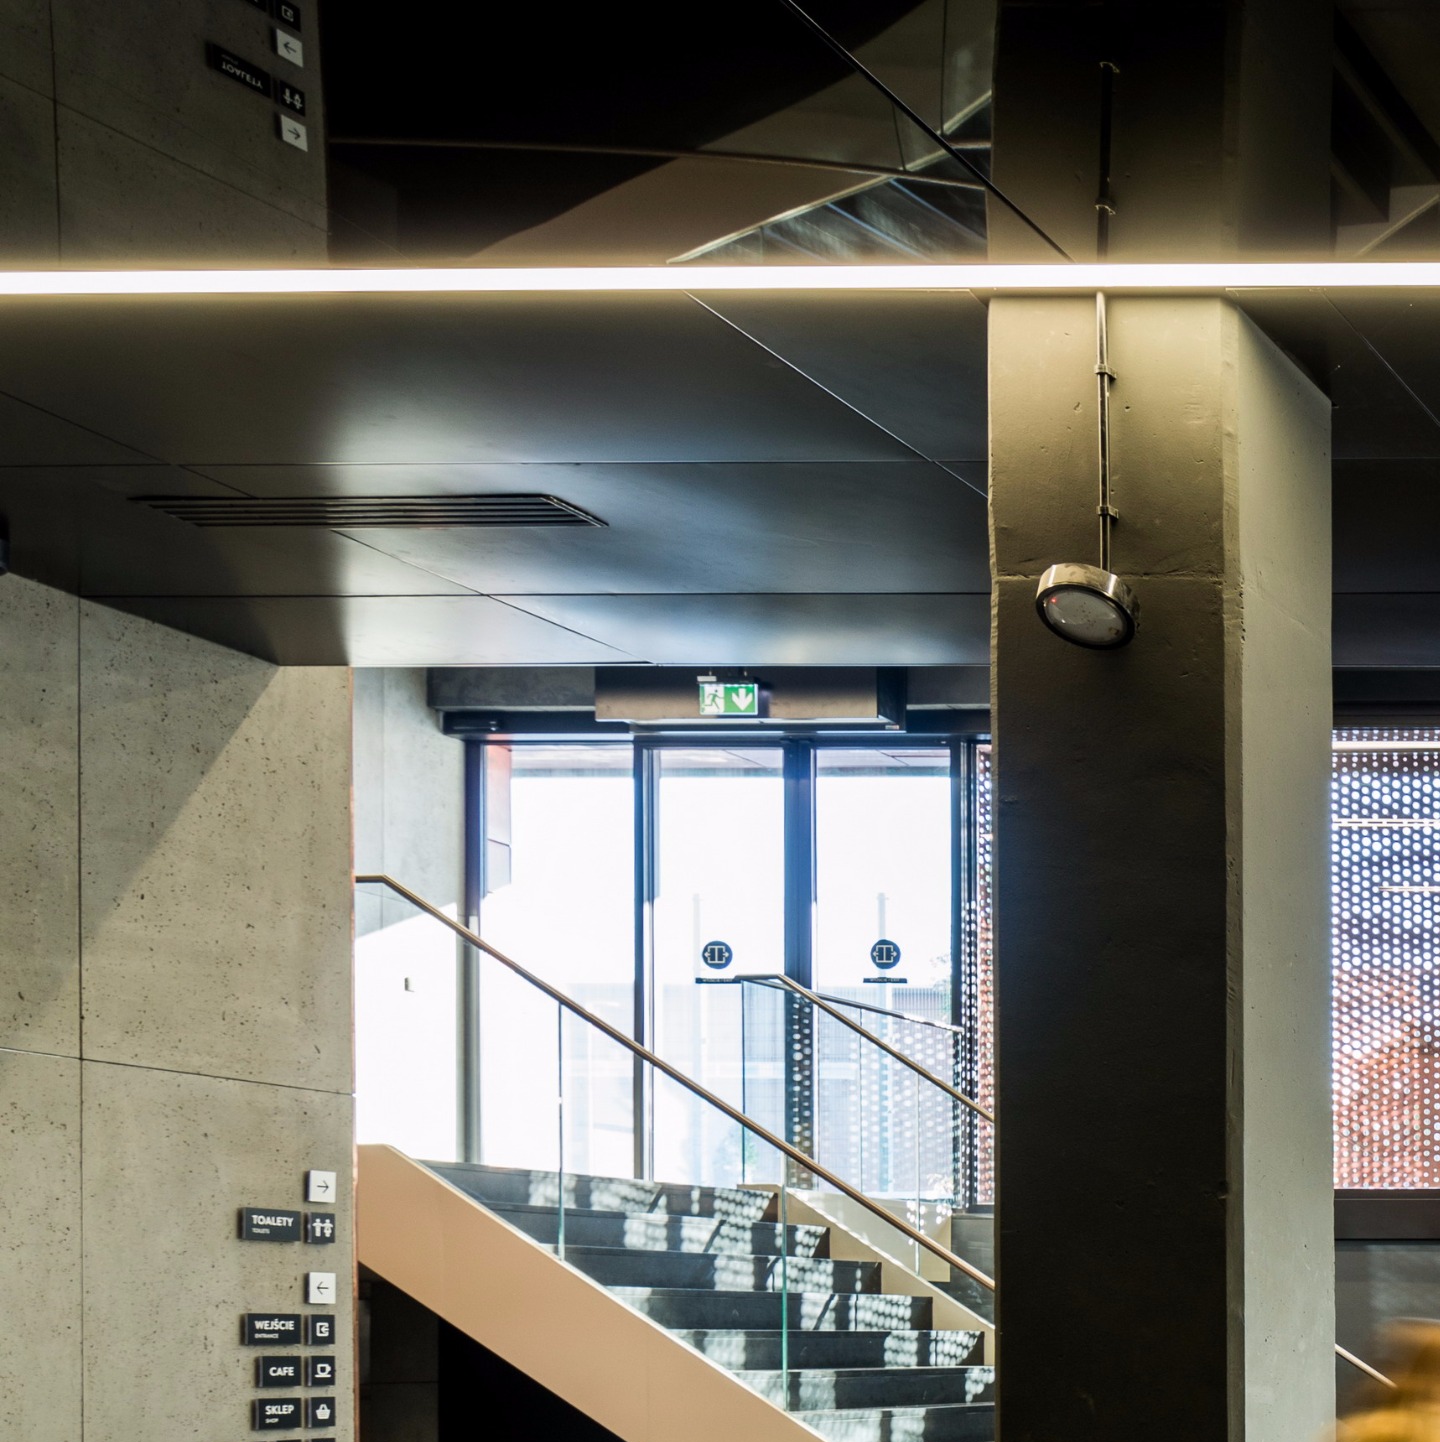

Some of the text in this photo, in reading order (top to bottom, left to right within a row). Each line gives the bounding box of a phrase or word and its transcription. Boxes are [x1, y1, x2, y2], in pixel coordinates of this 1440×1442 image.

[251, 1214, 294, 1227] TOALETY
[254, 1318, 295, 1330] WEJŚCIE
[269, 1366, 295, 1377] CAFE
[264, 1404, 295, 1415] SKLEP
